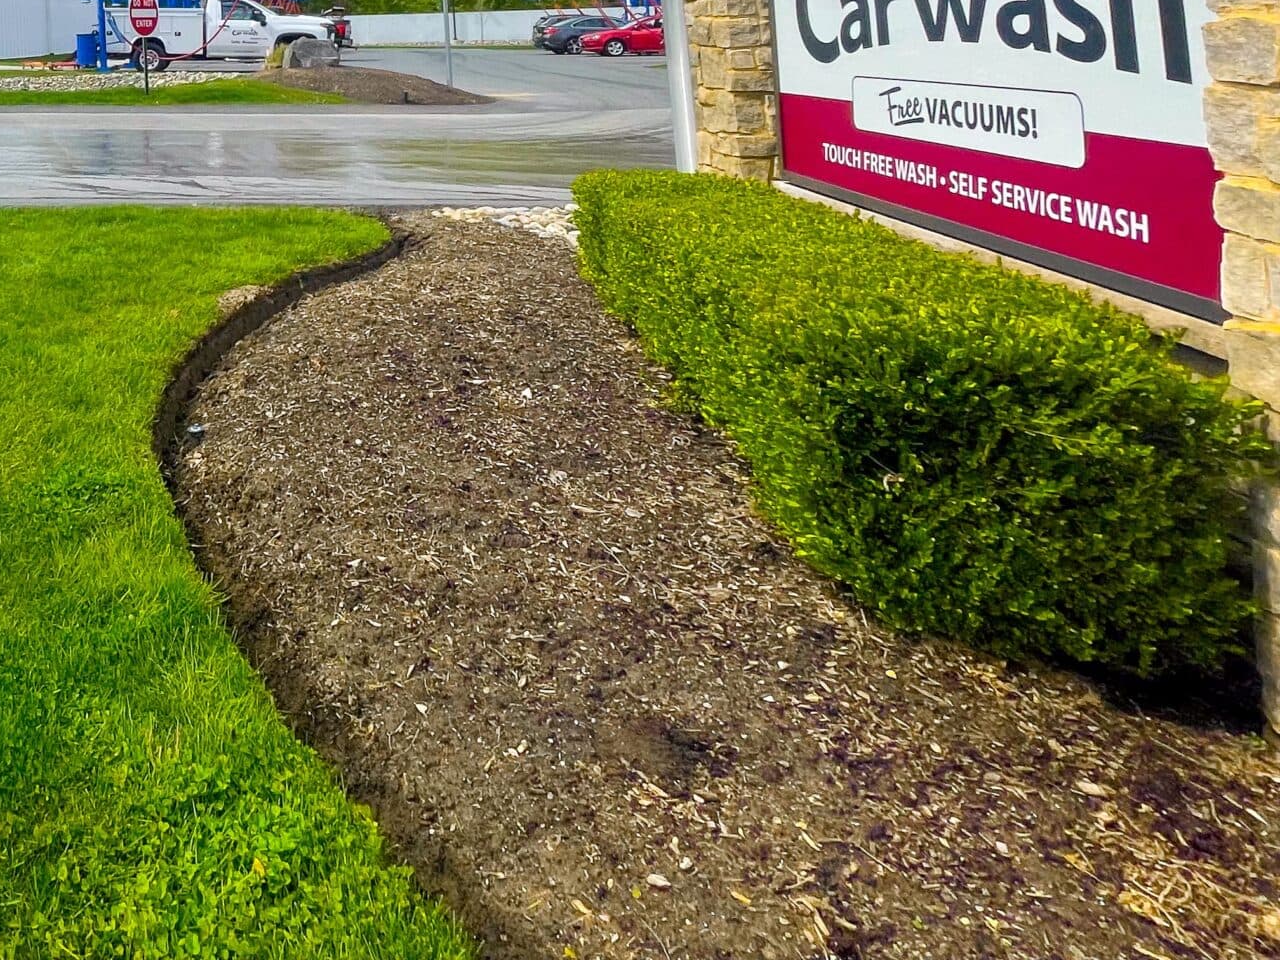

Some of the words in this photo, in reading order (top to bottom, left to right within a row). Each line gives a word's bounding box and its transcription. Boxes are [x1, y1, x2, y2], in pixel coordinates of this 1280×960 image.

[132, 0, 141, 8] DO
[143, 0, 154, 8] NOT
[135, 19, 153, 28] ENTER
[879, 86, 924, 125] Free
[925, 97, 1038, 139] VACUUMS!
[822, 142, 861, 169] TOUCH
[863, 152, 894, 178] FREE
[894, 158, 937, 188] WASH
[948, 170, 988, 201] SELF
[991, 180, 1073, 224] SERVICE
[1075, 198, 1150, 244] WASH
